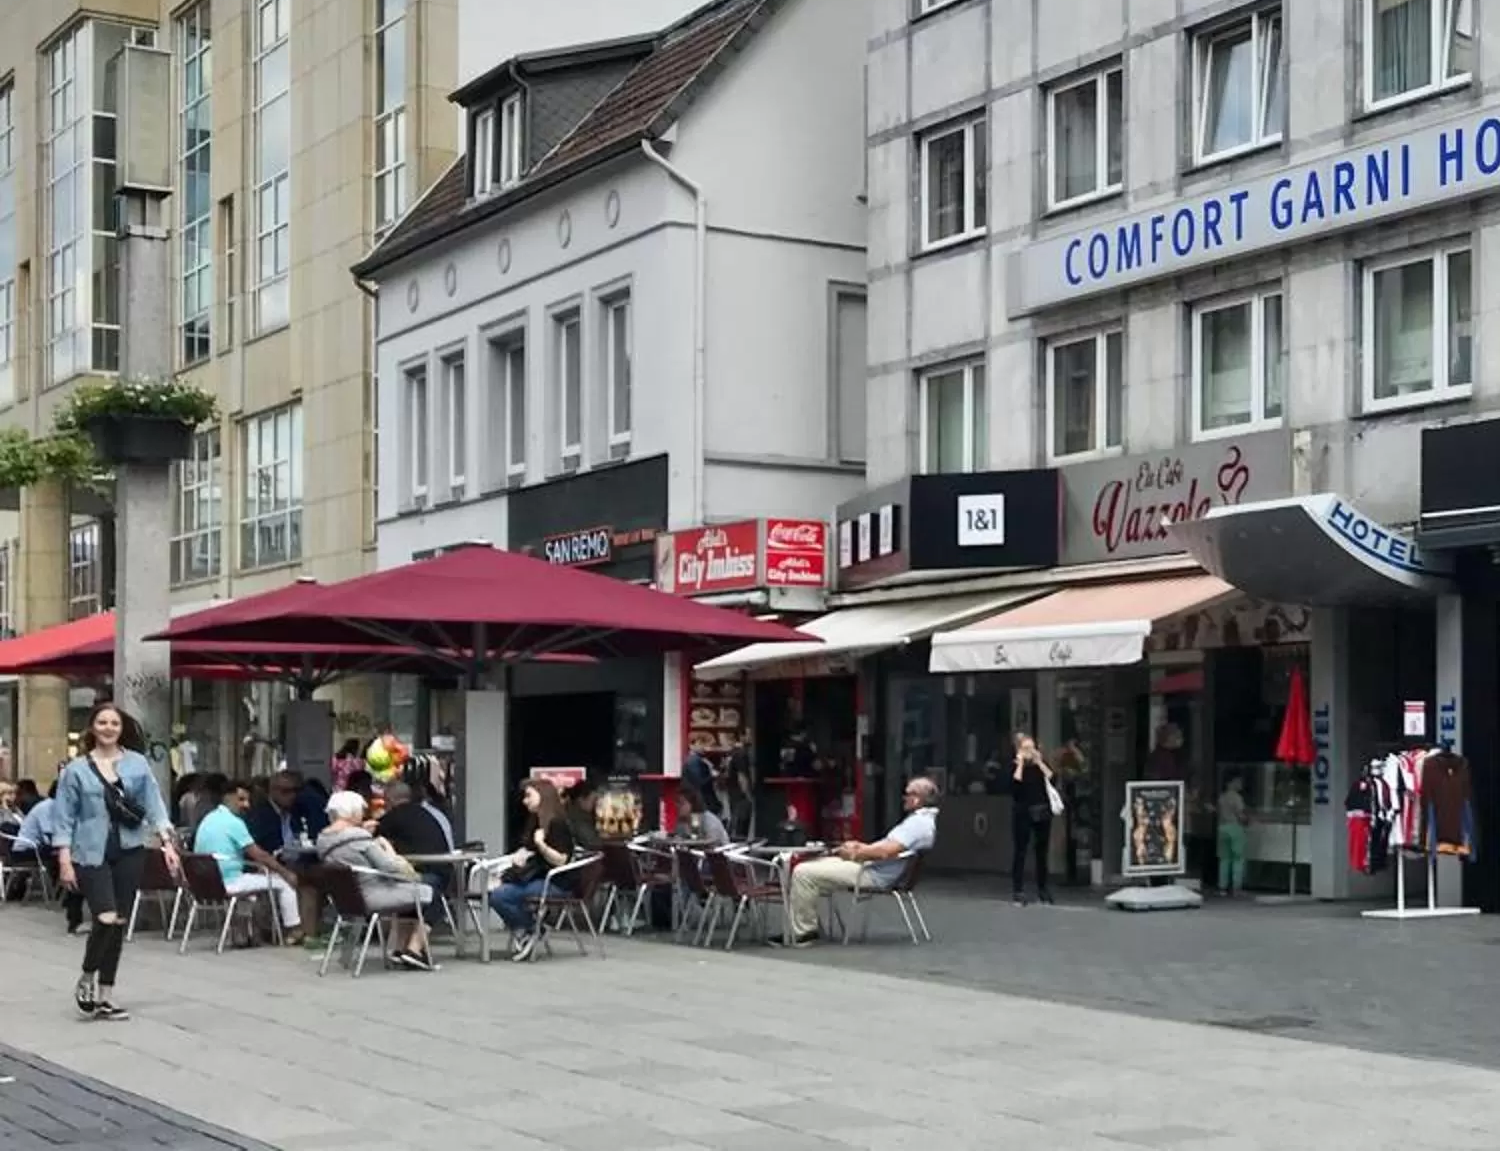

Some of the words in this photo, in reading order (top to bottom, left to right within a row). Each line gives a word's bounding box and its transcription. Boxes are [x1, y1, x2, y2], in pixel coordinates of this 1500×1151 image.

[1065, 191, 1249, 285] COMFORT
[1270, 144, 1410, 230] GARNI
[545, 539, 571, 565] SAN
[571, 530, 609, 561] REMO
[966, 508, 997, 531] 1&1
[1331, 502, 1425, 567] HOTEL
[678, 551, 705, 590] City
[705, 546, 755, 582] Imbiss
[1313, 702, 1330, 806] HOTEL
[1440, 696, 1457, 754] TEL
